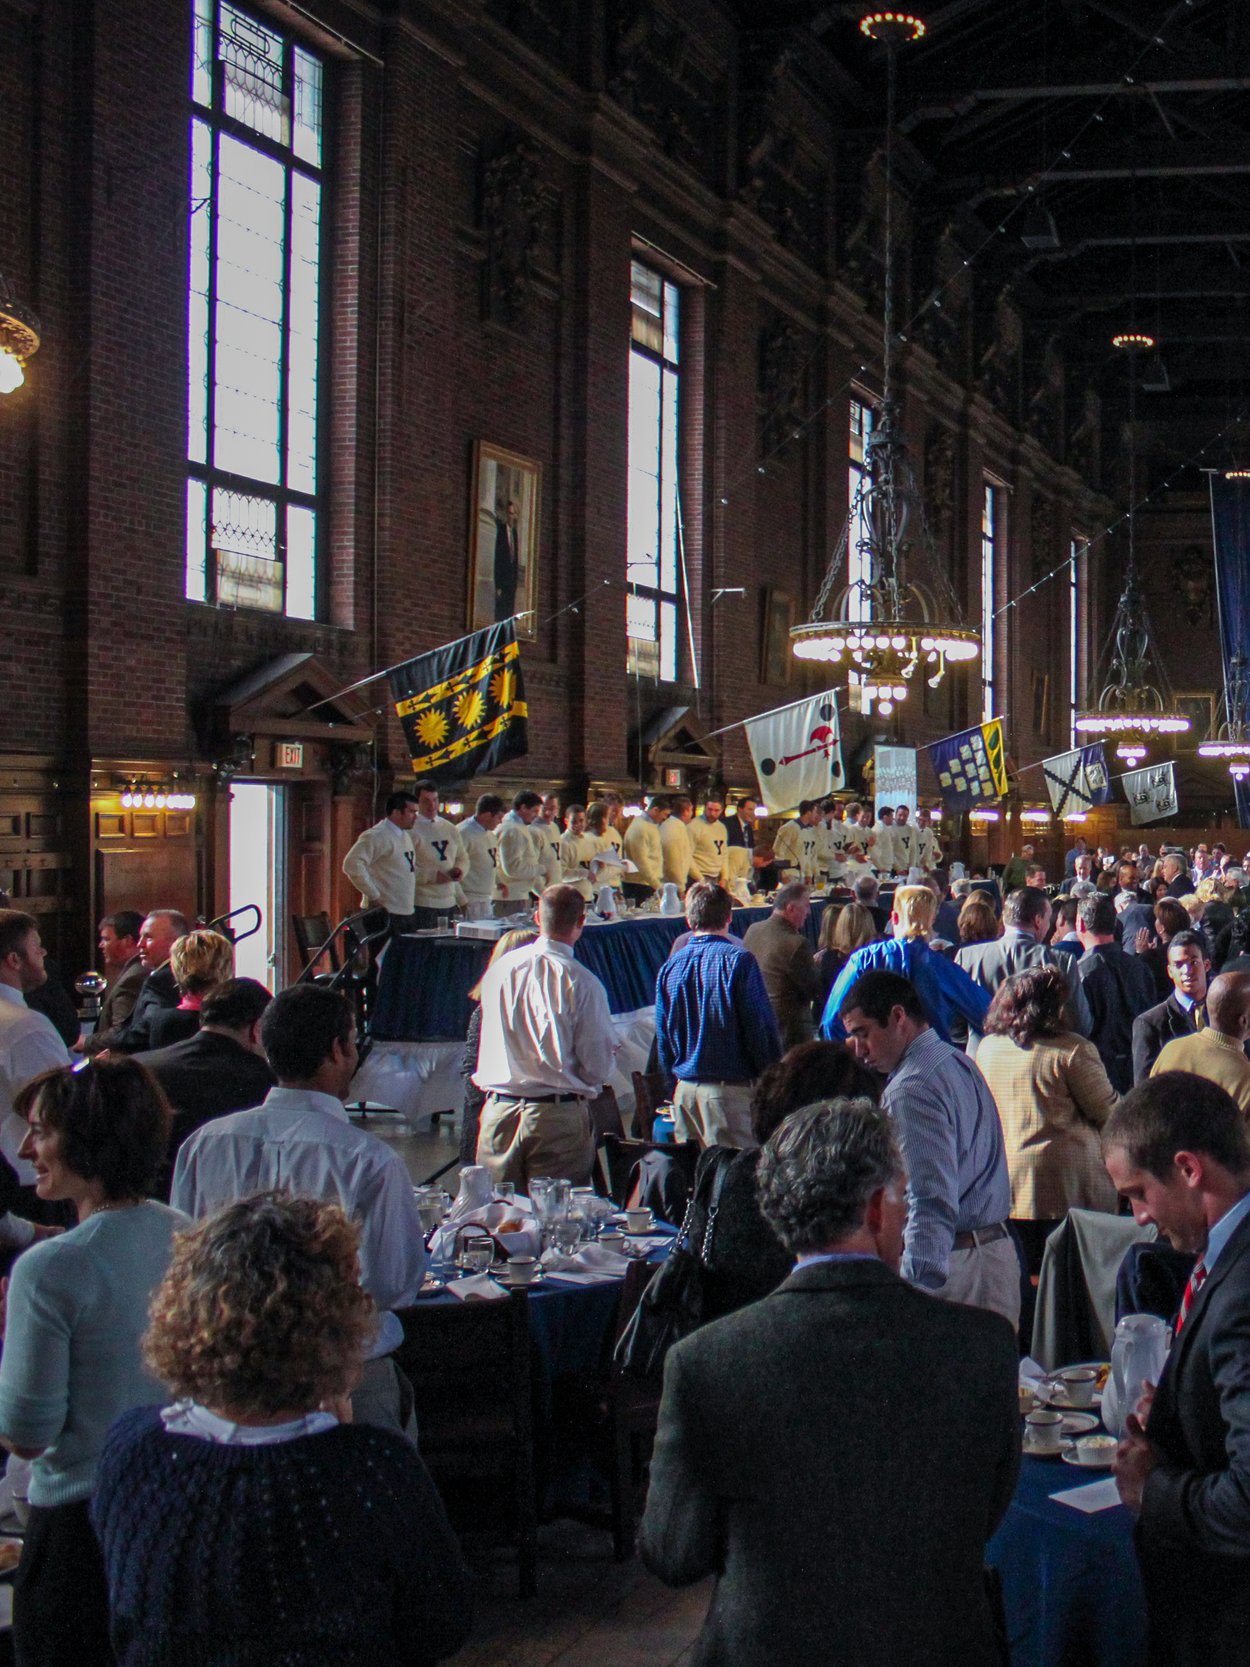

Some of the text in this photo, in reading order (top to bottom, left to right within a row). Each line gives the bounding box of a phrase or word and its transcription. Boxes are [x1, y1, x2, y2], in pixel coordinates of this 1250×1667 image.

[285, 746, 301, 765] EXIT
[431, 840, 449, 861] Y
[550, 841, 560, 861] Y
[713, 839, 724, 855] Y
[860, 842, 869, 855] Y
[902, 836, 910, 849] Y
[918, 843, 926, 855] Y
[404, 851, 415, 872] Y
[488, 847, 497, 868] Y
